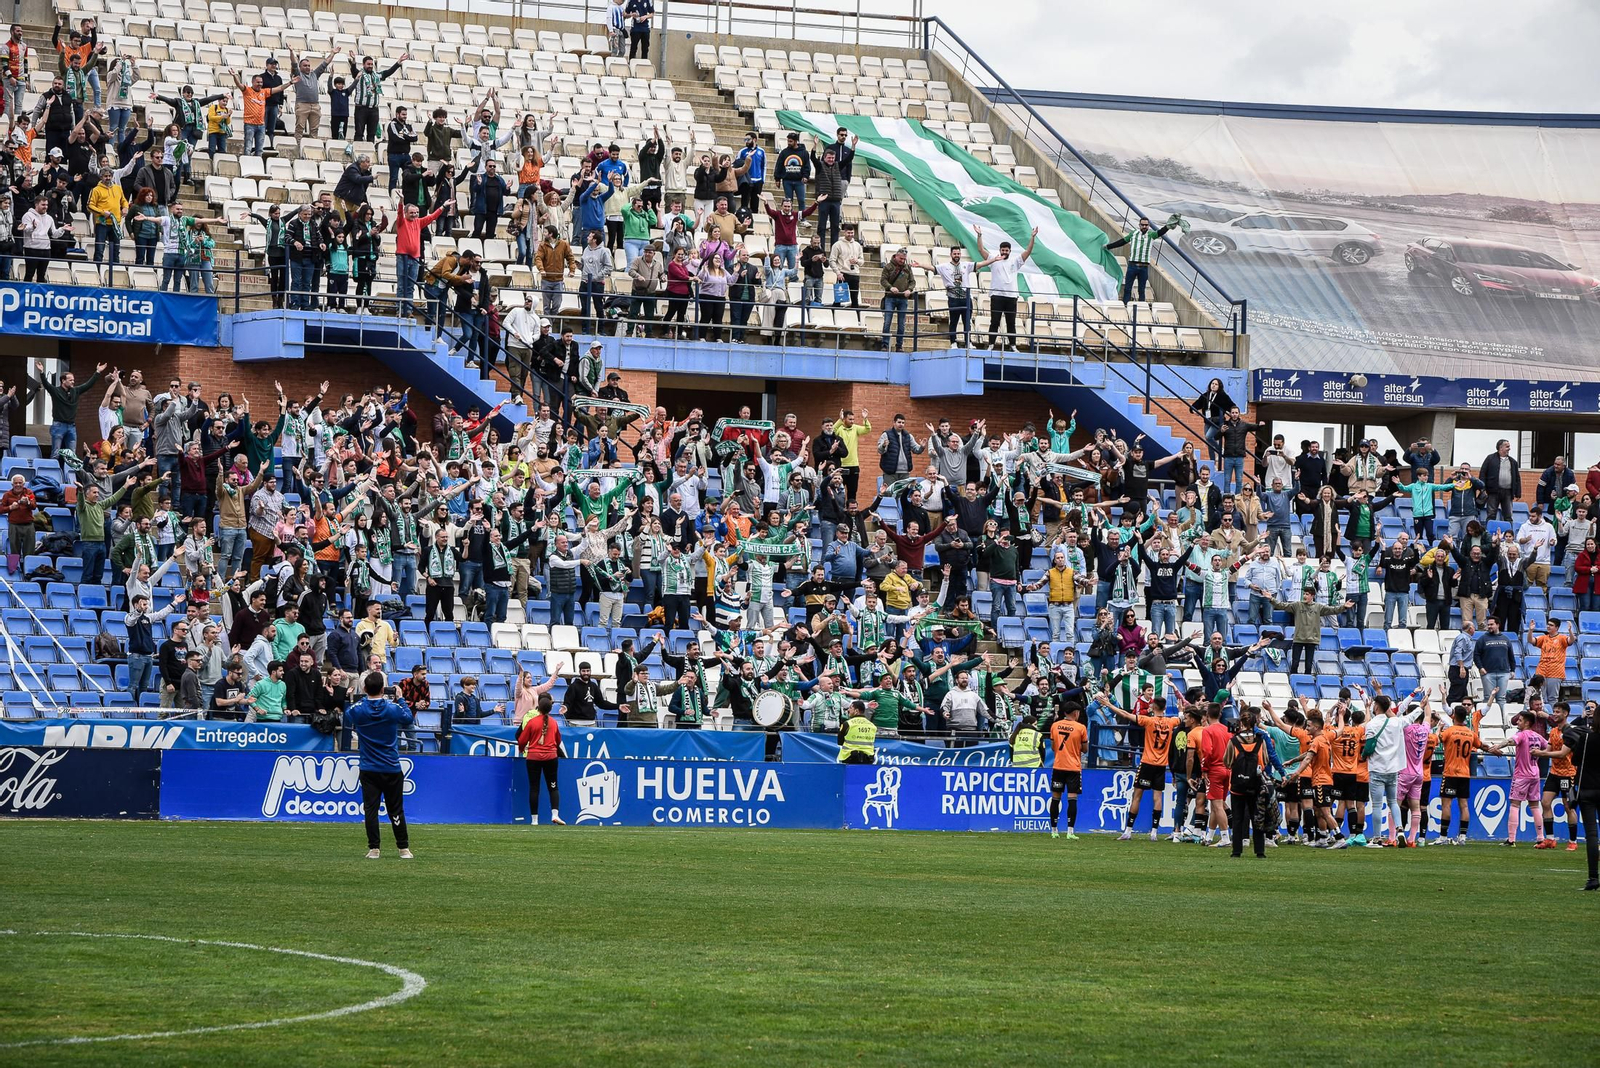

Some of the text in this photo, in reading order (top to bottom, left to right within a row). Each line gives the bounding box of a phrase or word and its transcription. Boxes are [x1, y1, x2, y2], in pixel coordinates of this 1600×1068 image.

[24, 289, 154, 315] informática
[23, 311, 152, 336] Profesional
[1262, 377, 1285, 388] alter
[1323, 380, 1346, 390] alter
[1384, 383, 1407, 393] alter
[1262, 386, 1302, 397] enersun
[1323, 389, 1363, 400] enersun
[1466, 387, 1491, 398] alter
[1529, 389, 1554, 399] alter
[1384, 392, 1424, 403] enersun
[1466, 396, 1510, 406] enersun
[1529, 398, 1573, 408] enersun
[745, 543, 781, 554] ANTEQUERA
[195, 727, 288, 747] Entregados
[1058, 732, 1070, 751] 7
[1153, 729, 1170, 750] 17
[1340, 740, 1357, 757] 18
[1454, 739, 1471, 759] 10
[637, 766, 786, 802] HUELVA
[941, 769, 1052, 793] TAPICERÍA
[652, 807, 770, 824] COMERCIO
[1014, 820, 1051, 831] HUELVA
